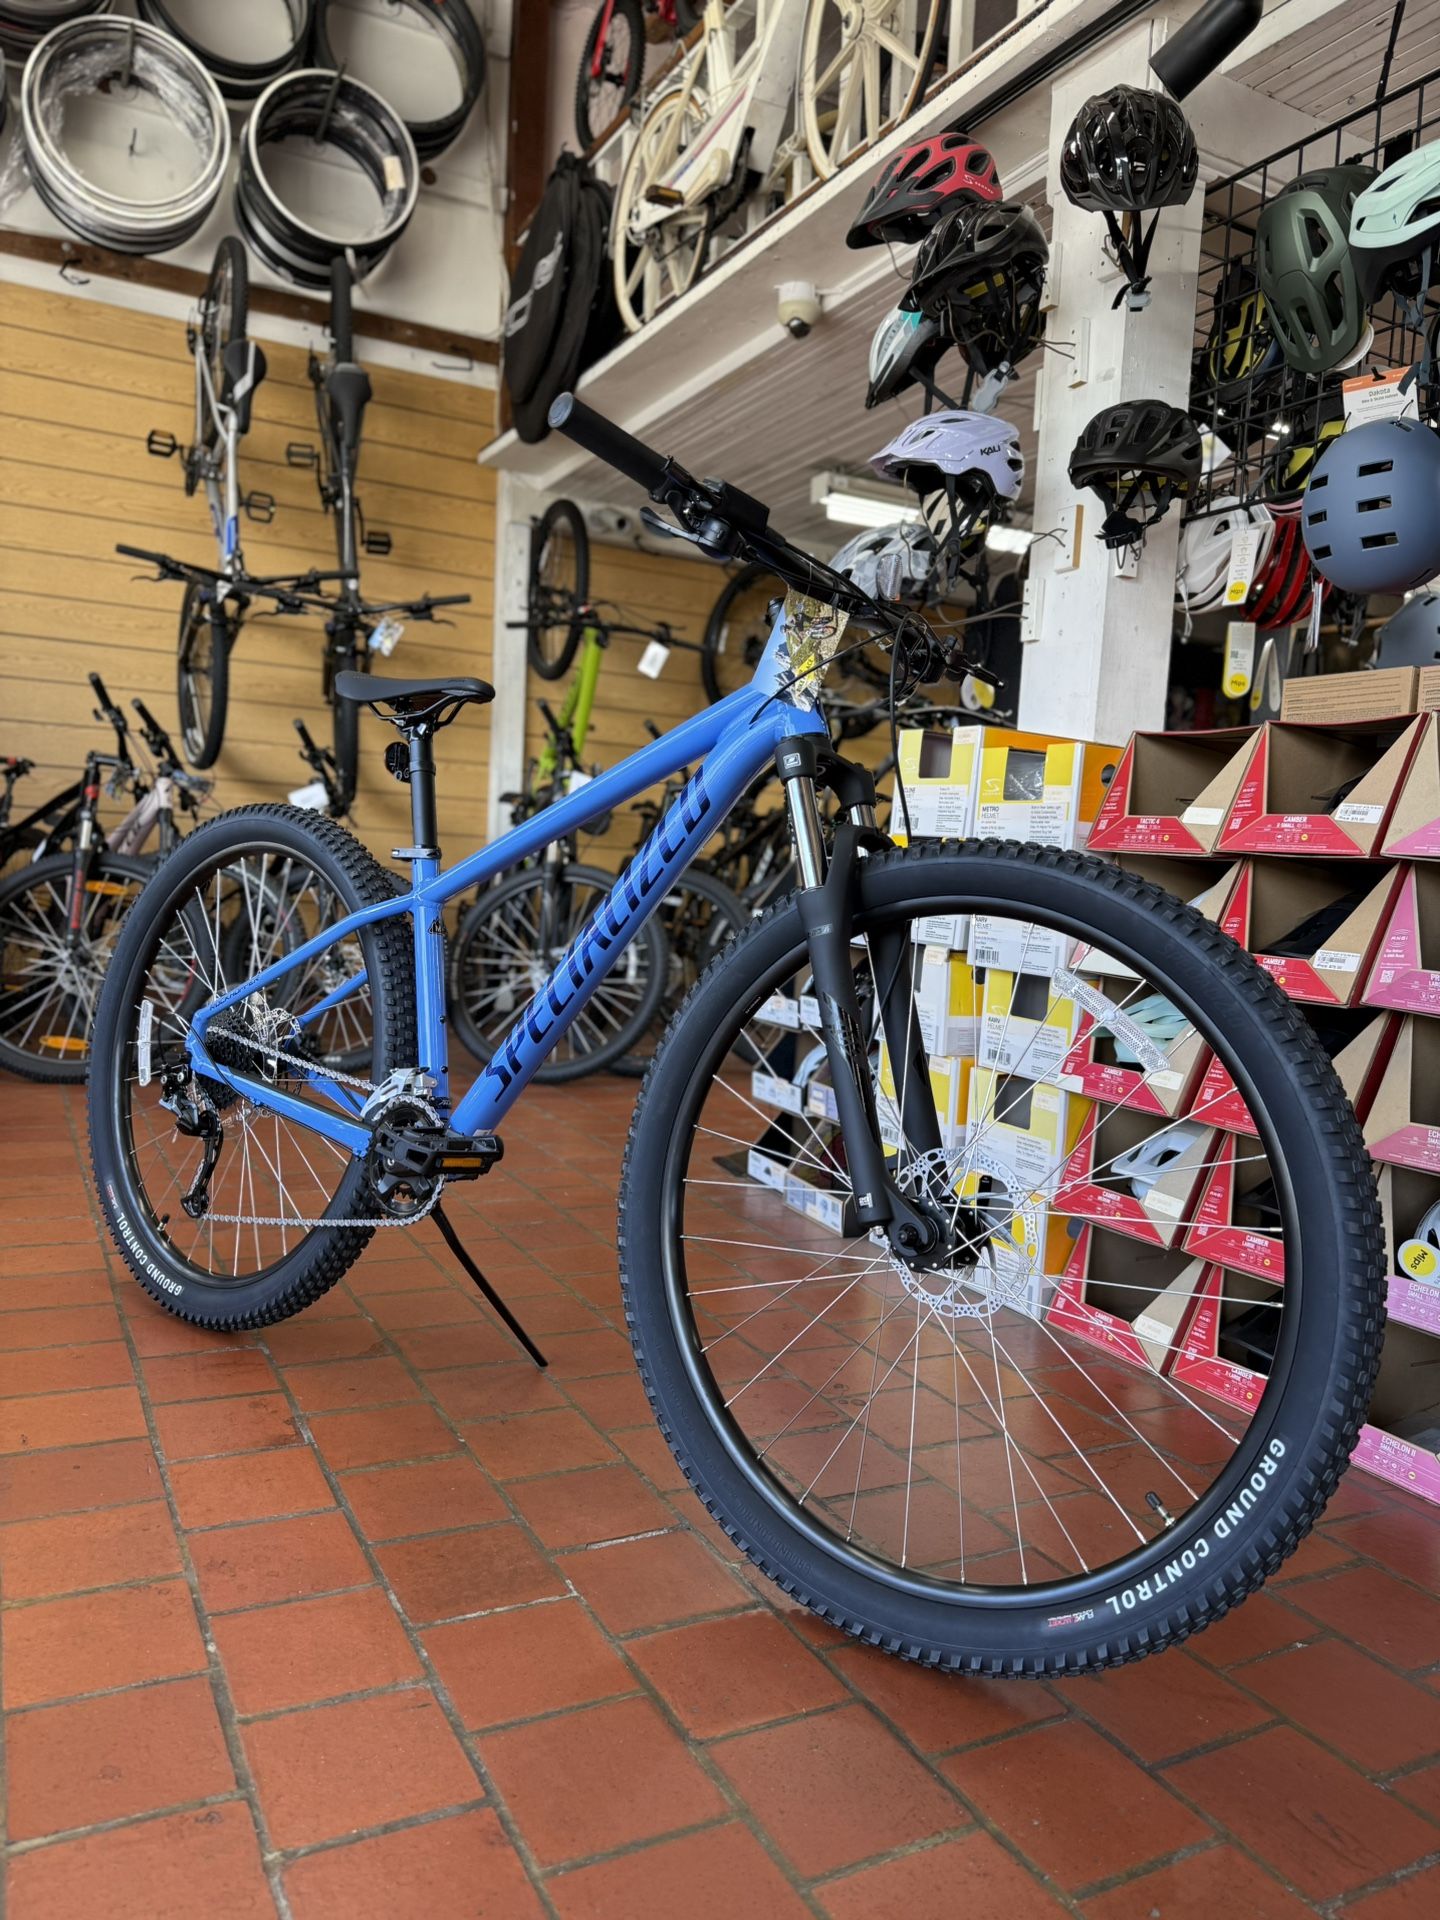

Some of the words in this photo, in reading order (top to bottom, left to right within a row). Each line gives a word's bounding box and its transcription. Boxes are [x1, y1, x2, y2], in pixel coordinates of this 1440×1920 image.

[1369, 387, 1391, 397] Dakota
[980, 444, 1001, 456] KALI
[1283, 815, 1307, 823] CAMBER
[486, 765, 711, 1103] SPECIALIZED
[1263, 957, 1286, 966] CAMBER
[1104, 1067, 1123, 1077] CAMBER
[116, 1212, 149, 1265] CONTROL
[1245, 1234, 1269, 1247] CAMBER
[1411, 1249, 1428, 1270] Mips
[147, 1265, 183, 1296] GROUND
[1409, 1282, 1440, 1298] ECHELON
[1381, 1435, 1411, 1455] ECHELON
[1213, 1438, 1285, 1539] GROUND
[1105, 1538, 1210, 1615] CONTROL
